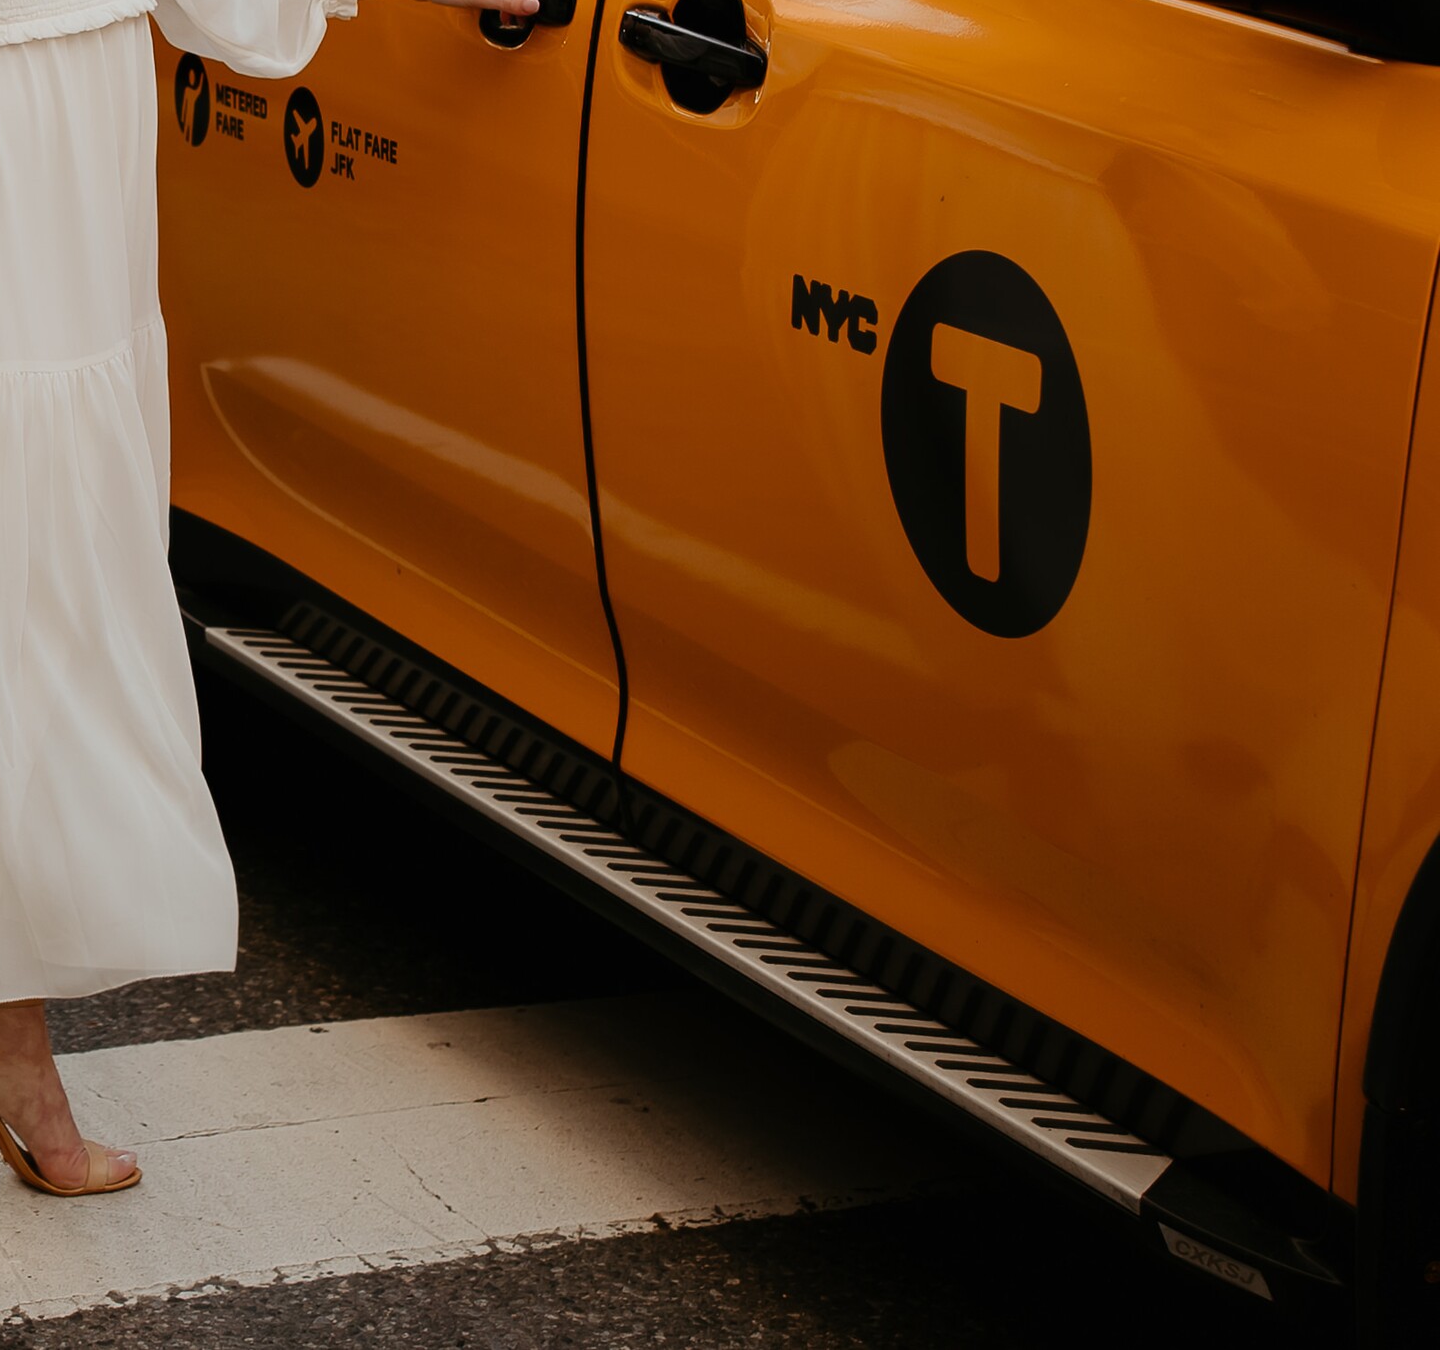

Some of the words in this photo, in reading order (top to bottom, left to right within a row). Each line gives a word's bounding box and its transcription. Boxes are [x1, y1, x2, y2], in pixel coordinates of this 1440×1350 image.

[215, 83, 267, 119] METERED
[215, 112, 244, 141] FARE
[331, 121, 362, 151] FLAT
[365, 132, 398, 164] FARE
[330, 152, 355, 181] JFK
[791, 273, 878, 355] NYC
[931, 322, 1042, 583] T
[1175, 1240, 1256, 1284] CXKSJ
